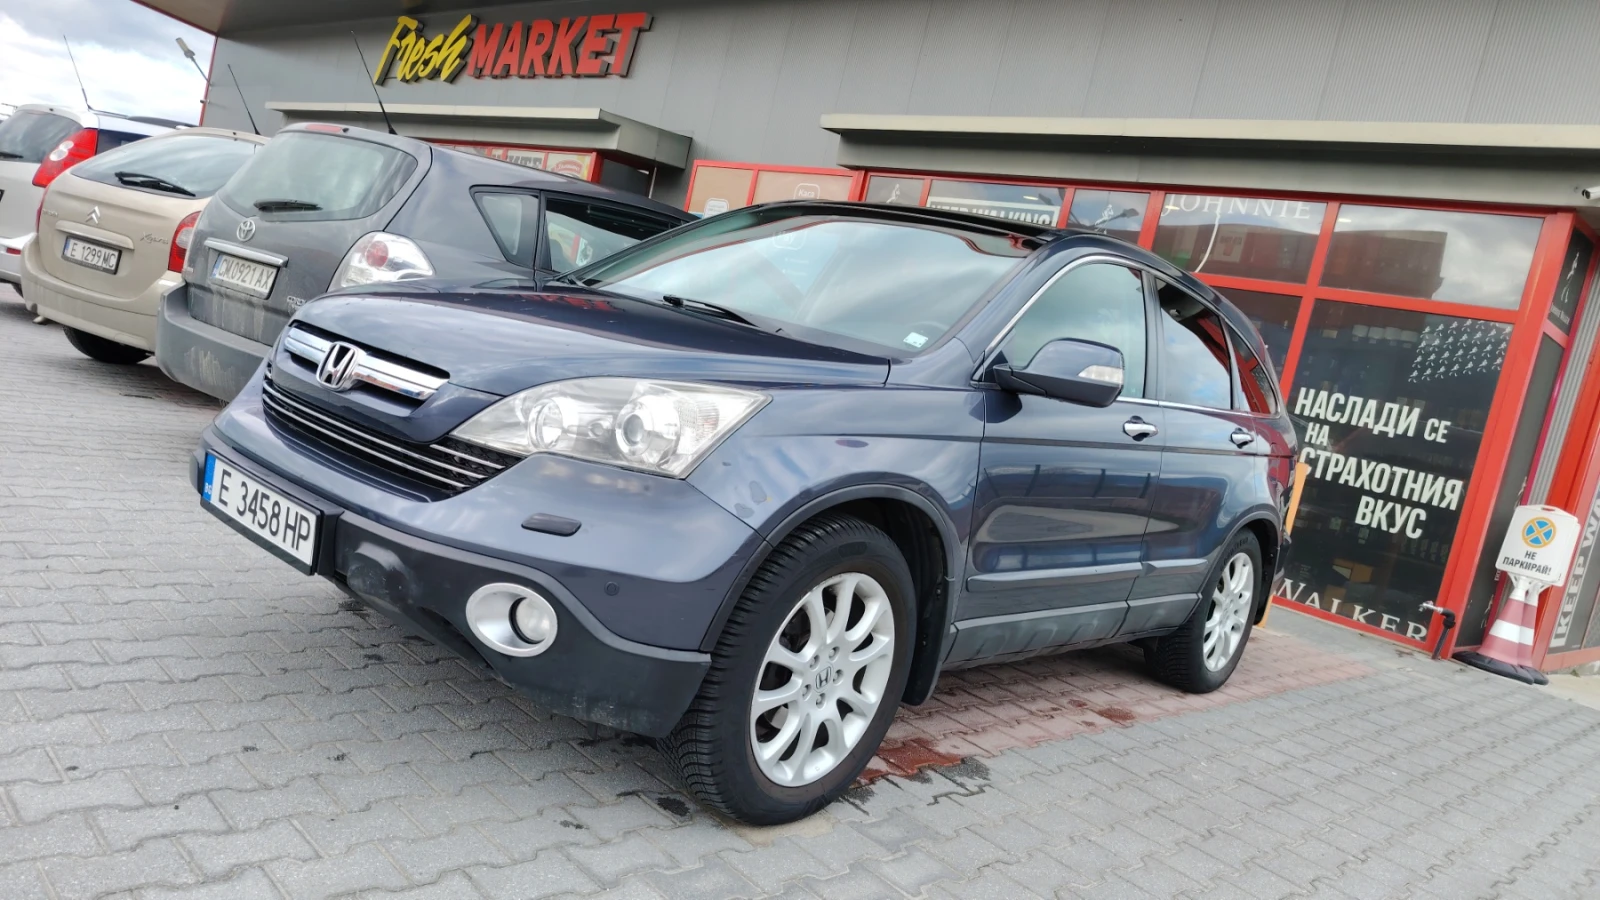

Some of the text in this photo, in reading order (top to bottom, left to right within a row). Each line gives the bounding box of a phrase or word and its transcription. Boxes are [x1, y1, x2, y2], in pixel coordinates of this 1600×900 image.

[373, 12, 648, 85] Fresh MARKET
[70, 242, 78, 258] E
[81, 245, 102, 268] 1299
[102, 252, 117, 271] MC
[231, 262, 257, 285] 0921
[255, 269, 274, 290] AX
[1294, 387, 1452, 444] НАСЛАДИ СЕ
[1304, 421, 1330, 447] НА
[218, 468, 311, 551] E 3458 HP
[1354, 495, 1428, 539] ВКУС
[1502, 556, 1552, 576] ПАРКИРАЙ!
[1524, 550, 1538, 561] НЕ
